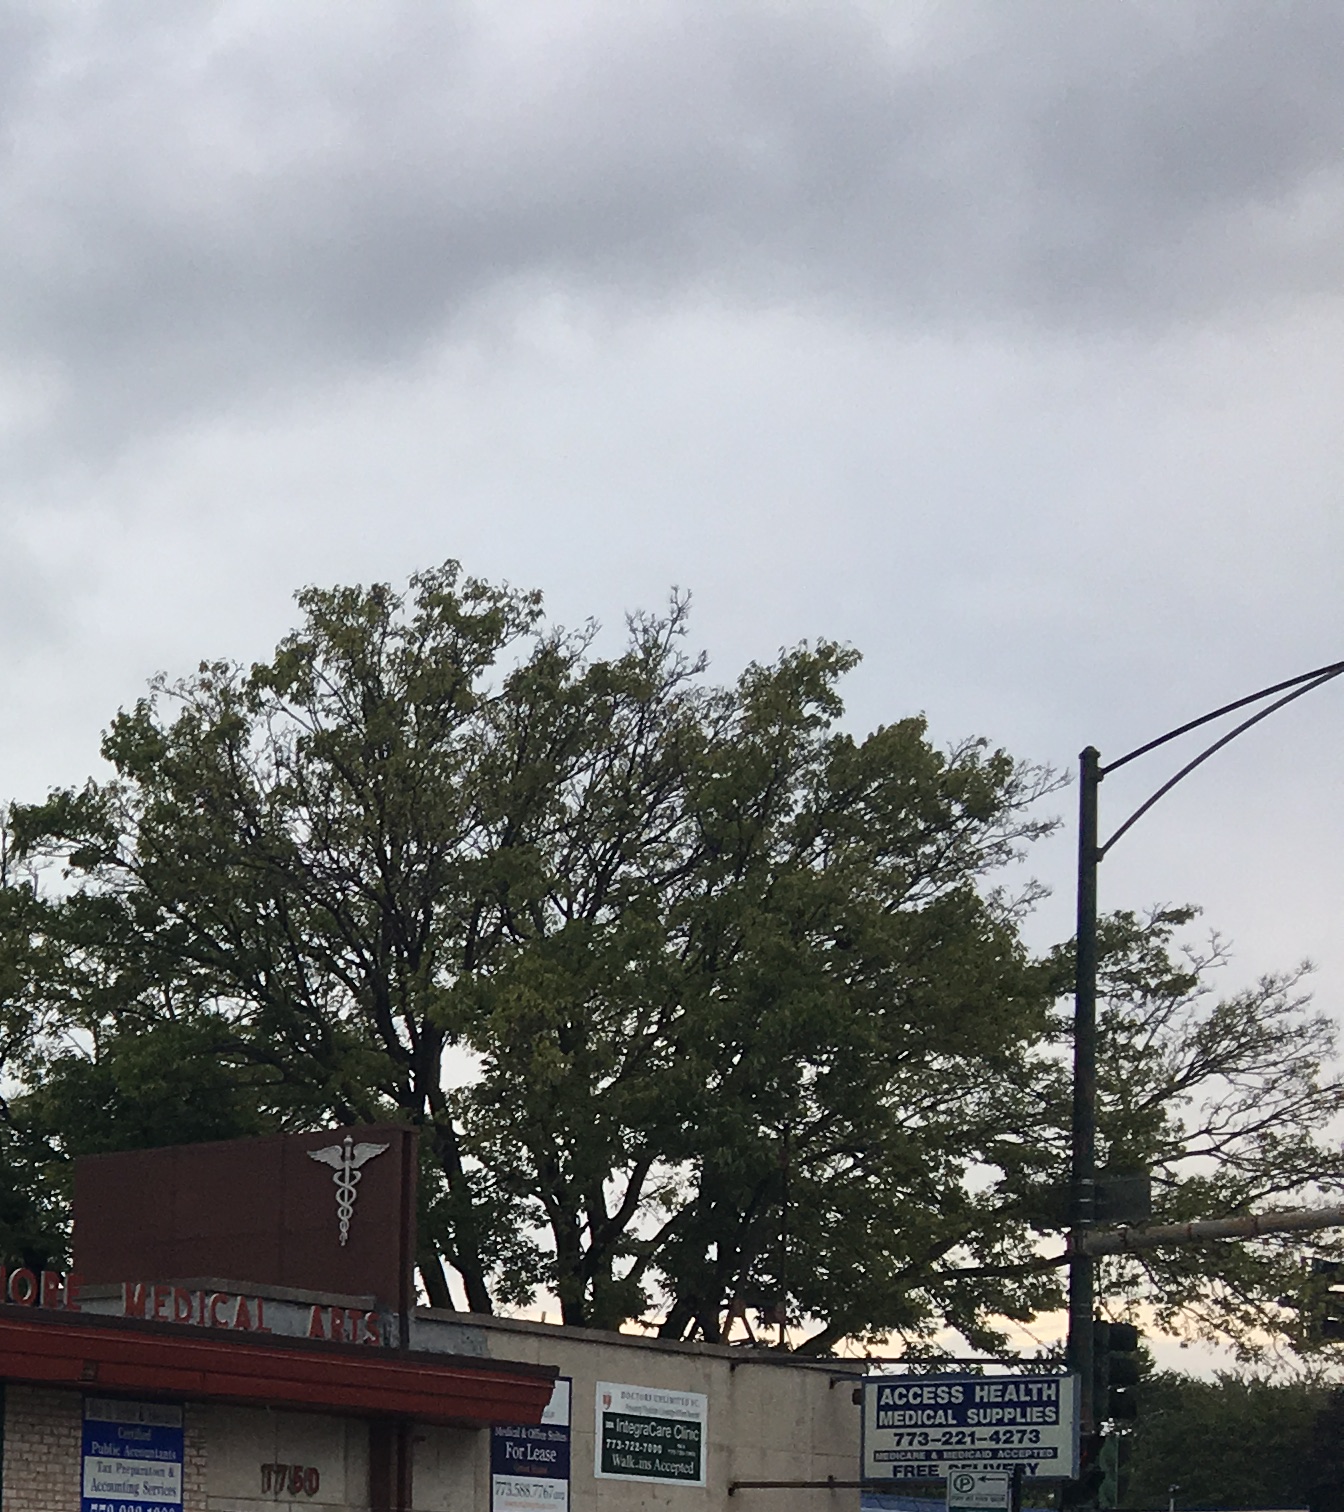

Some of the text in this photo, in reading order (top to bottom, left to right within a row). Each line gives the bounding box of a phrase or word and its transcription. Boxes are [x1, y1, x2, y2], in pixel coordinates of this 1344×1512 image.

[123, 1281, 272, 1333] MEDICAL
[308, 1305, 382, 1347] ARTS
[880, 1383, 1057, 1406] ACCESS HEALTH
[879, 1406, 1057, 1426] MEDICAL SUPPLIES
[893, 1429, 1041, 1447] 773-221-4273
[505, 1441, 557, 1463] For Lease
[875, 1450, 929, 1462] MEDICARE
[943, 1449, 992, 1460] MEDICAID
[997, 1448, 1054, 1459] ACCEPTED
[97, 1461, 112, 1474] Tax
[653, 1458, 694, 1475] Accepted
[892, 1464, 940, 1477] FREE
[91, 1478, 140, 1497] Accounting
